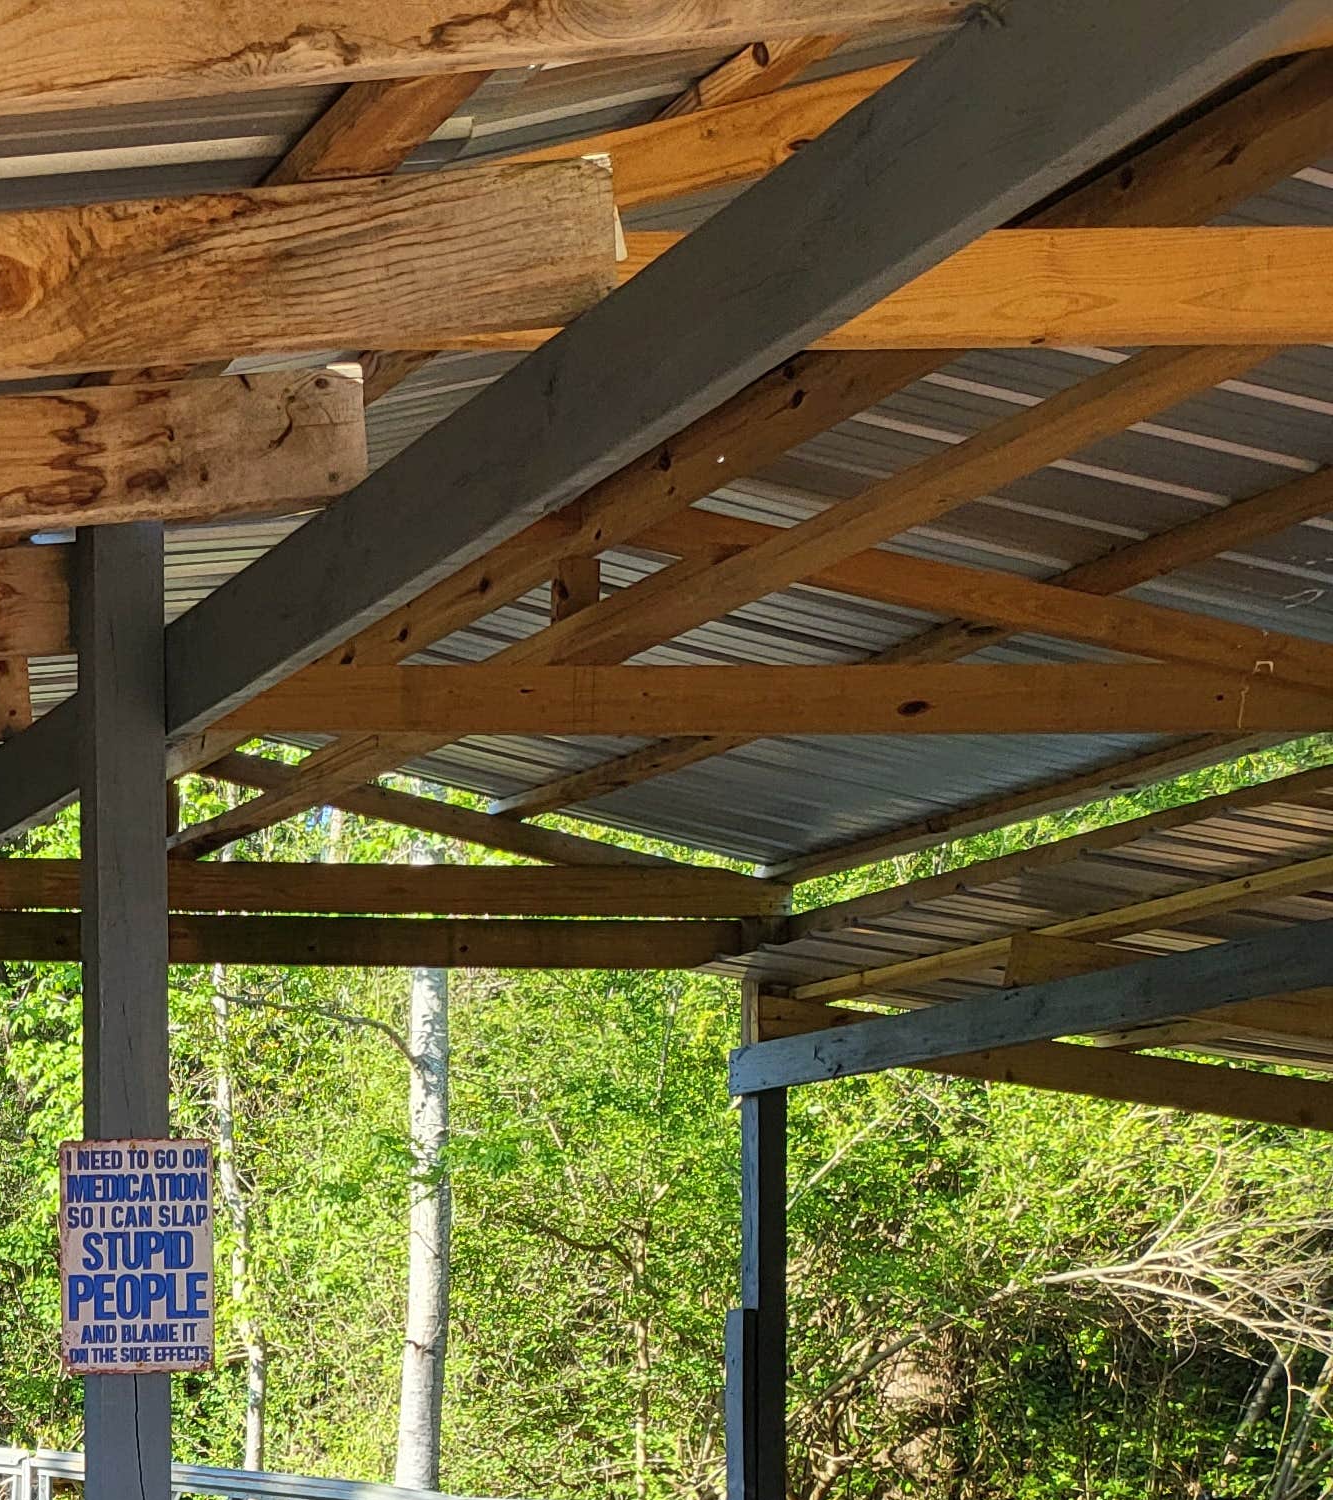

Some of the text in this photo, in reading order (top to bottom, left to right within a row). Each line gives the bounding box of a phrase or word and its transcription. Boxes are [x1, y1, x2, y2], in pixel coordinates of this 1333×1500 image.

[67, 1149, 207, 1170] I NEED TO GO ON
[67, 1172, 207, 1203] MEDICATION
[67, 1205, 207, 1228] SO I CAN SLAP
[83, 1231, 193, 1271] STUPID
[68, 1272, 209, 1321] PEOPLE
[81, 1323, 197, 1344] AND BLAME IT
[69, 1346, 209, 1363] ON THE SIDE EFFECTS
